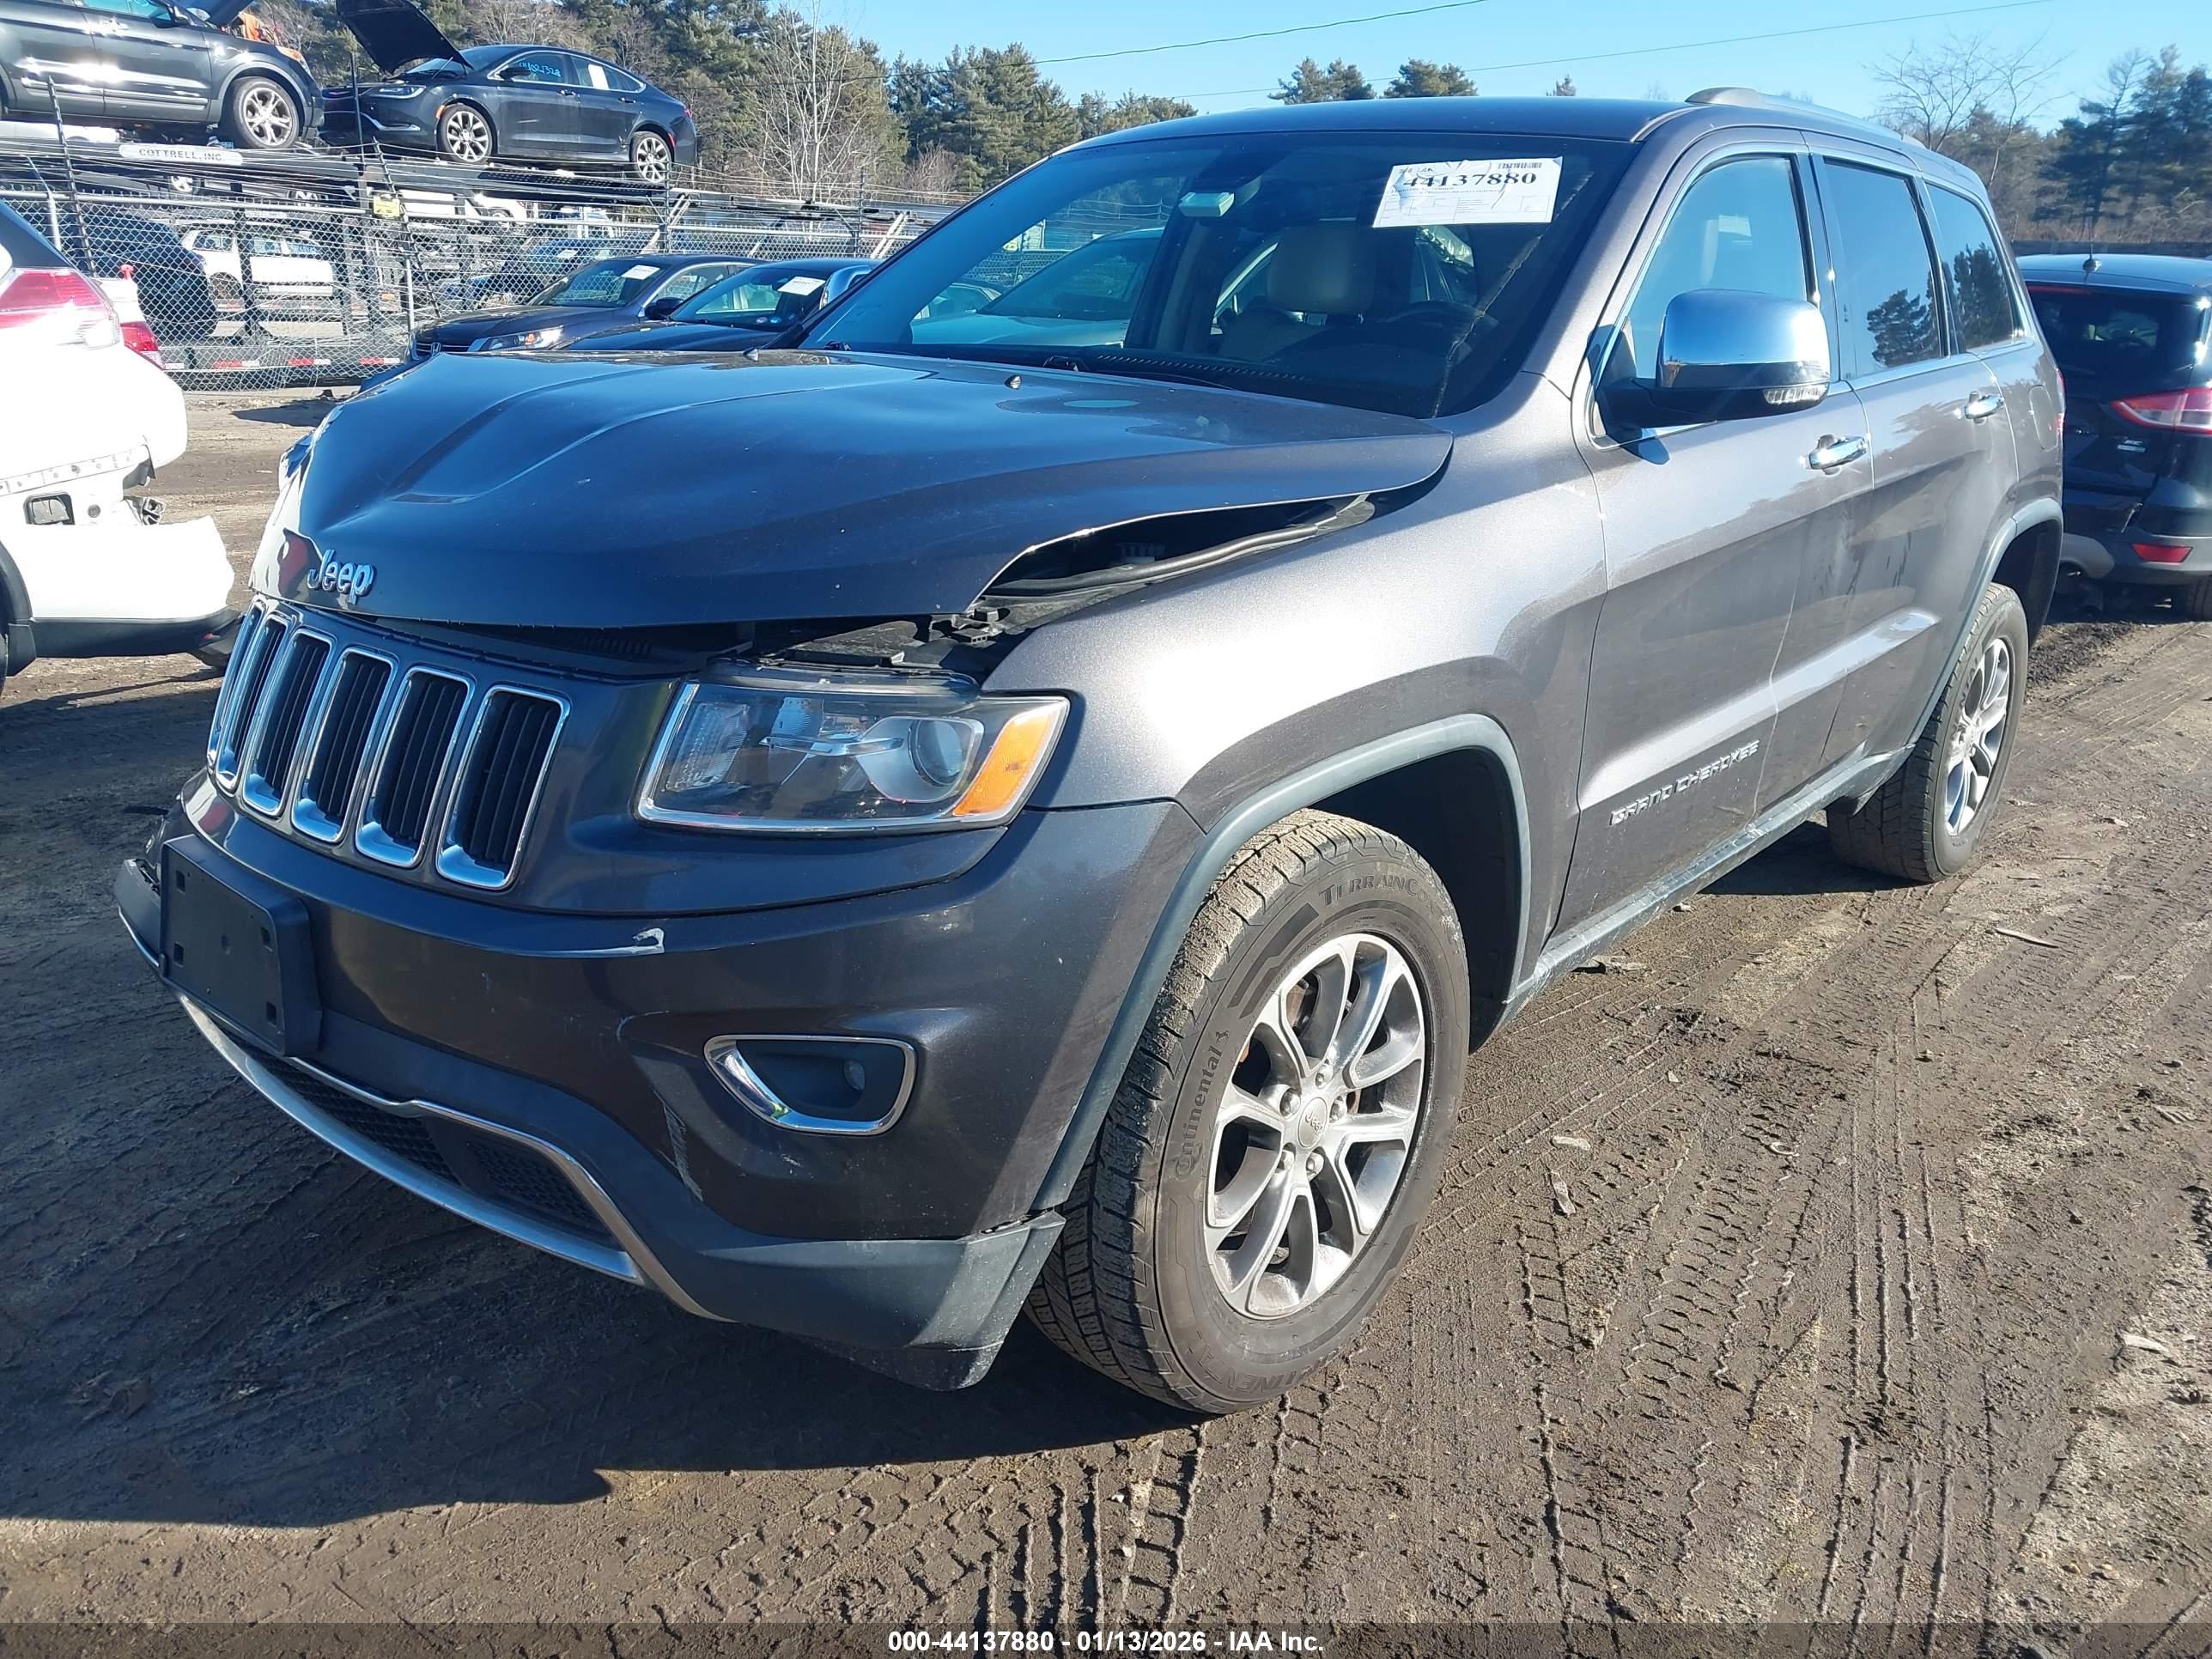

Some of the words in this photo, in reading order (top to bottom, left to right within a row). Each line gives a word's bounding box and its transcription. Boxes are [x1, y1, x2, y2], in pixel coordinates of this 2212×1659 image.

[139, 149, 204, 161] COTTRELL,
[1403, 172, 1537, 187] 44137880
[307, 550, 374, 605] Jeep
[1609, 784, 1674, 826] GRAND
[1674, 739, 1759, 793] CHEROKEE
[1175, 1045, 1224, 1178] Continental
